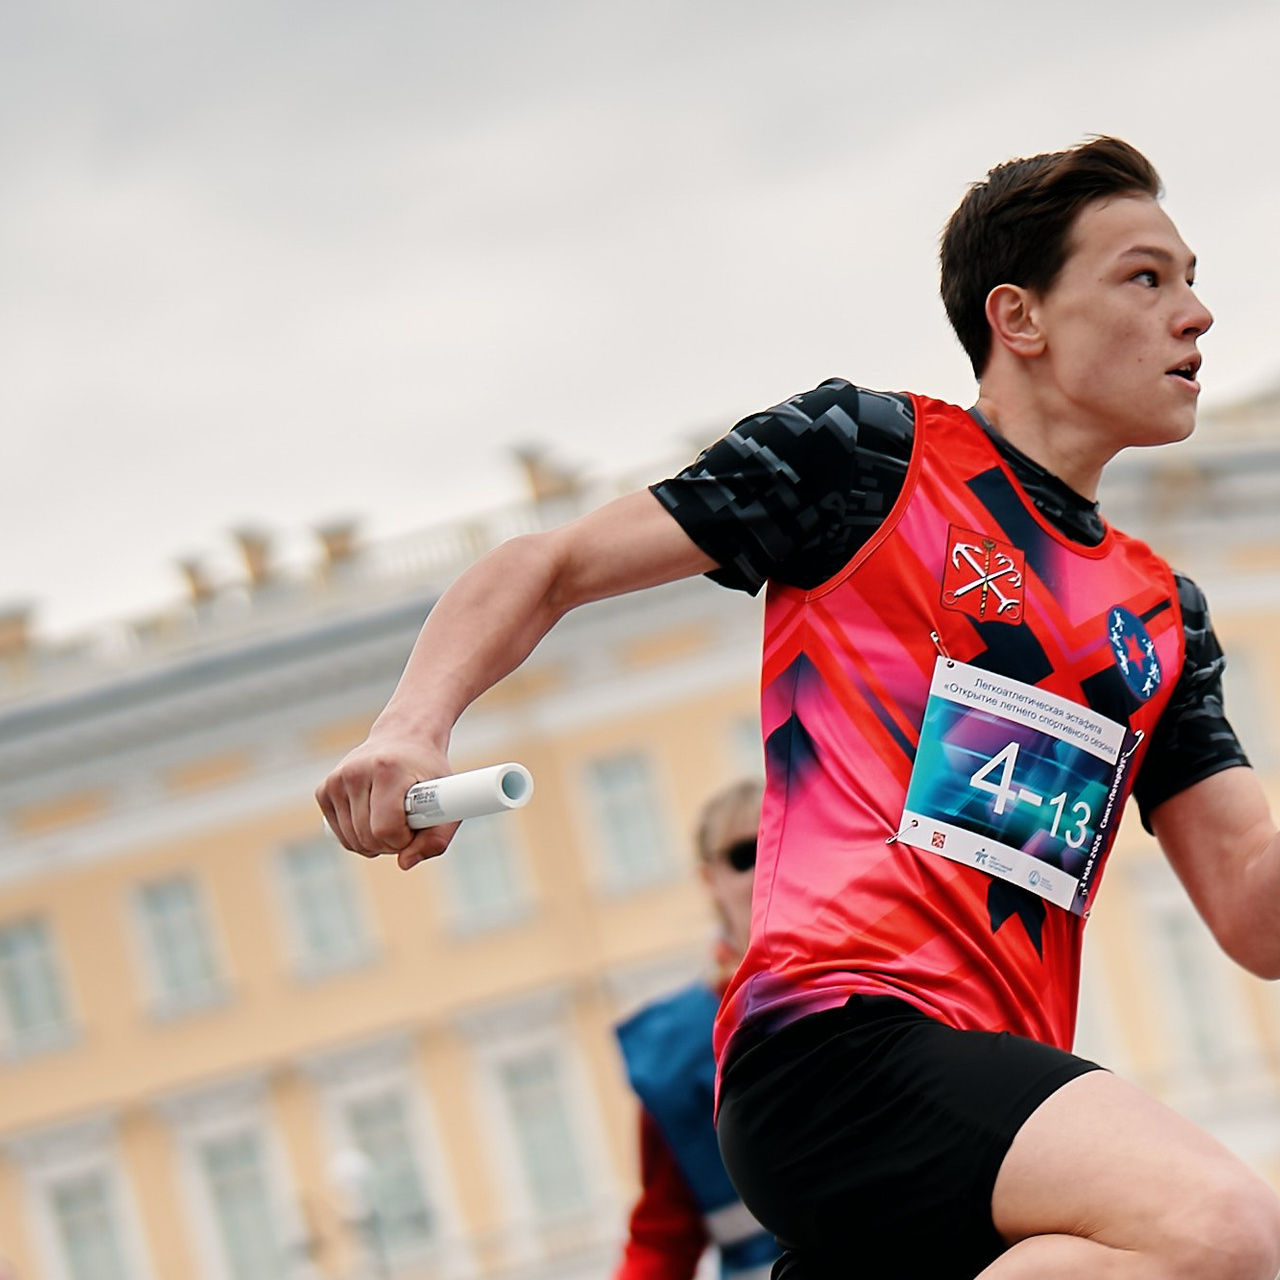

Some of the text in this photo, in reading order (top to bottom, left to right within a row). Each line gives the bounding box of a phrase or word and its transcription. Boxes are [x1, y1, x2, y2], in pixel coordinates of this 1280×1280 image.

[944, 683, 998, 706] «Открытие
[999, 700, 1037, 720] летнего
[1038, 715, 1090, 742] спортивного
[974, 678, 1103, 735] Легкоатлетическая эстафета
[1090, 834, 1103, 860] 2026
